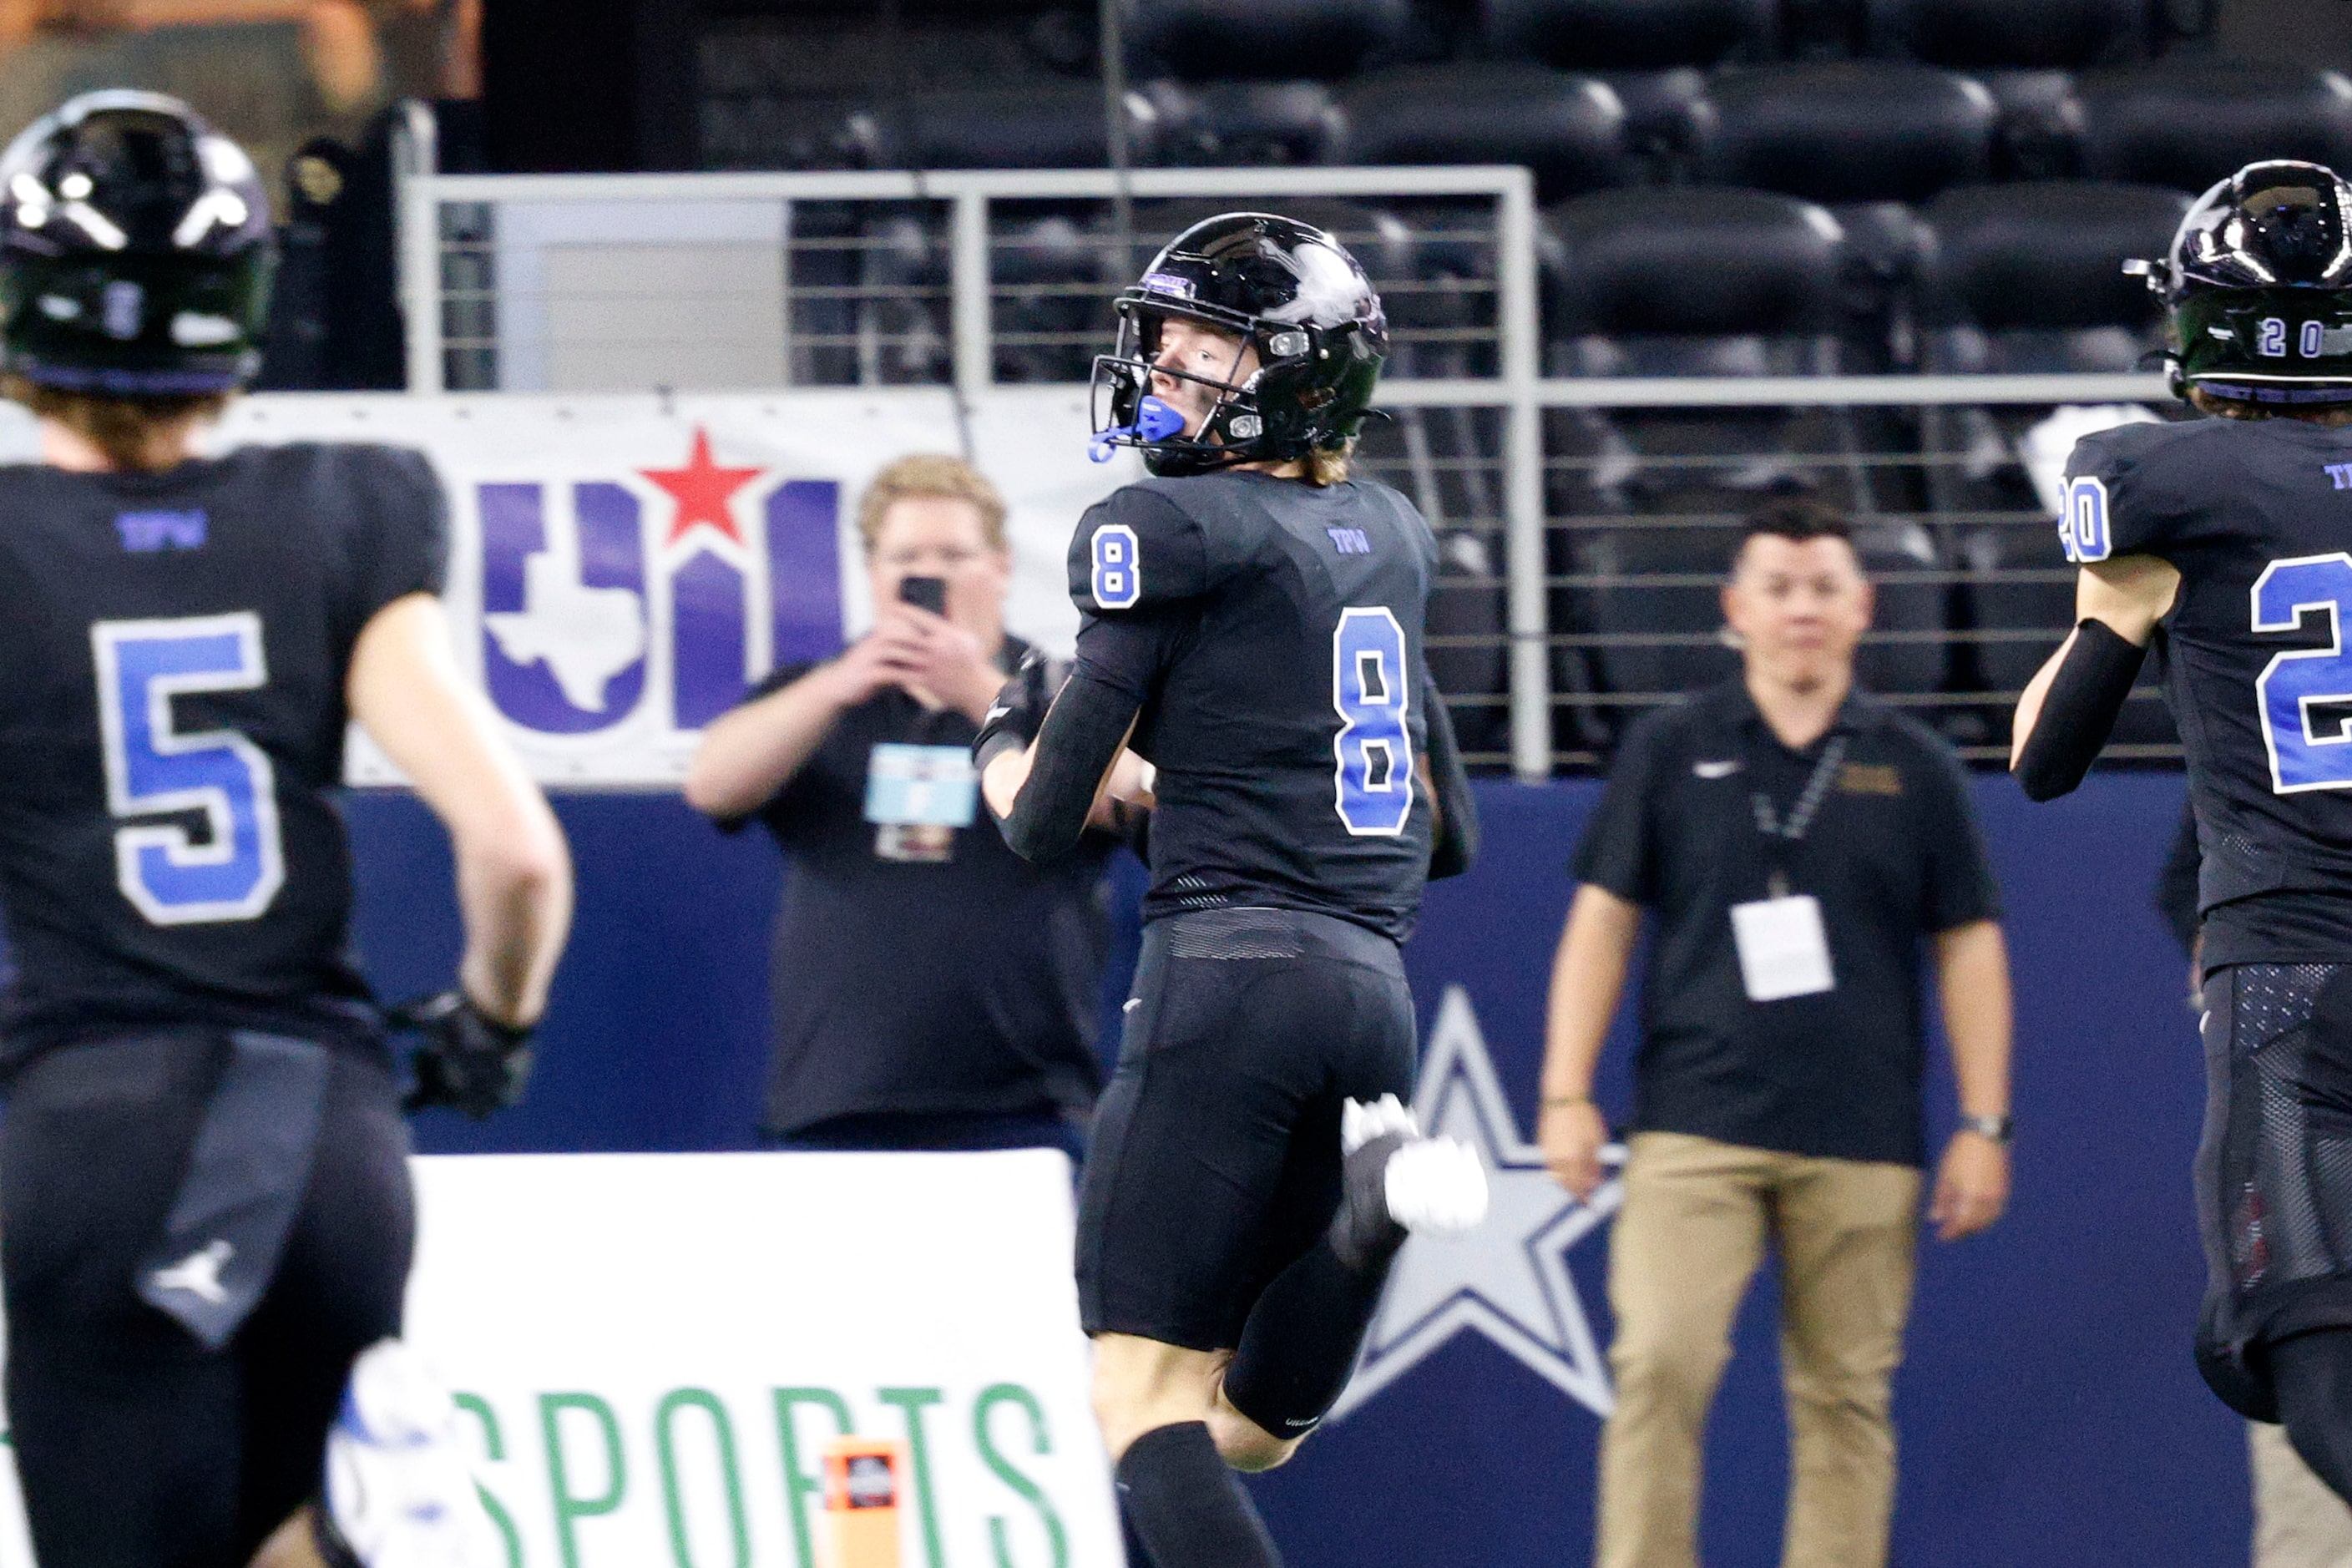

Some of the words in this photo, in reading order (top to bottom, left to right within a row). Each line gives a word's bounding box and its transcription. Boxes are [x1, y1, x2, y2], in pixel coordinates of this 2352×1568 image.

[1091, 524, 1141, 609] 8
[1326, 528, 1371, 554] TPW
[91, 610, 286, 926] 5
[1333, 606, 1414, 836] 8
